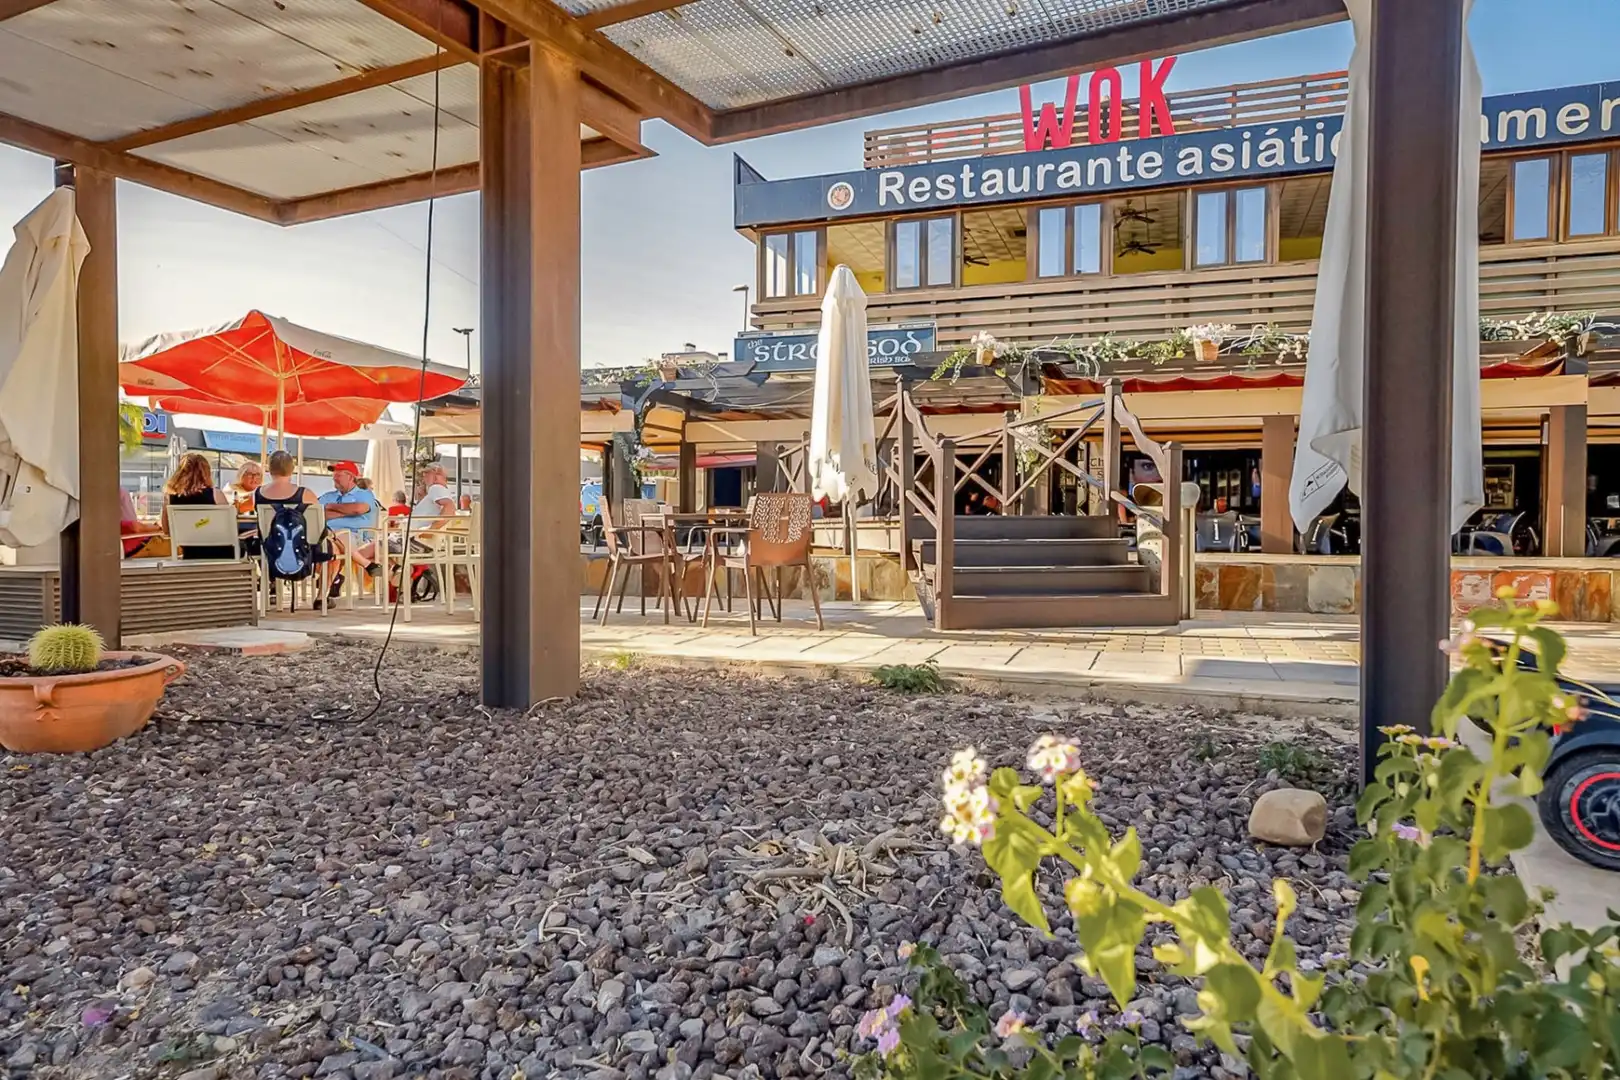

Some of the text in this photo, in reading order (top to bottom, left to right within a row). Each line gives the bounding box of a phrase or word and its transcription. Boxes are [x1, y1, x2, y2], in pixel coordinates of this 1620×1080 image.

[1019, 56, 1178, 152] WOK
[878, 146, 1164, 206] Restaurante
[1176, 121, 1342, 176] asiáti
